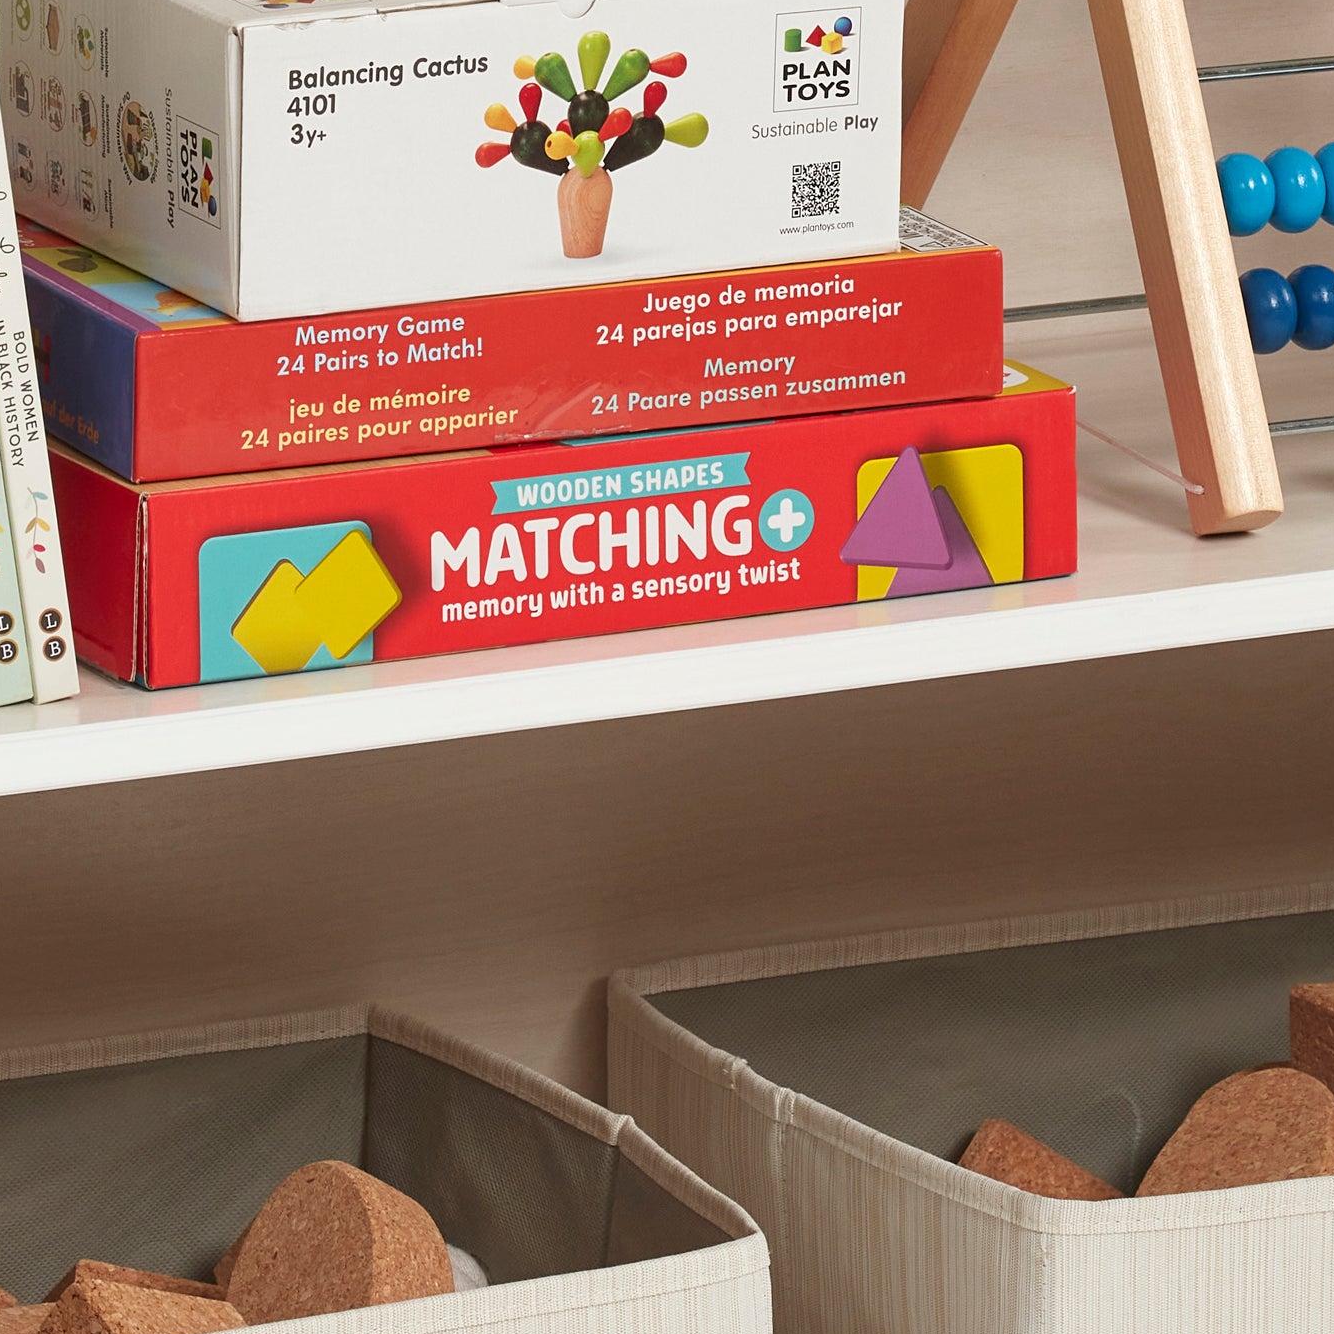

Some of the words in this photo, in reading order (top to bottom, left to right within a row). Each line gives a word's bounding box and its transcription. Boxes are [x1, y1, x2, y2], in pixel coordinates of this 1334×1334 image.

[289, 62, 403, 89] Balancing
[413, 55, 488, 78] Cactus
[783, 59, 851, 81] PLAN
[287, 93, 336, 117] 4101
[783, 80, 851, 102] TOYS
[752, 117, 838, 139] Sustainable
[845, 114, 879, 132] Play
[180, 130, 190, 203] TOYS
[189, 131, 199, 208] PLAN
[780, 220, 854, 235] www.plantoys.com
[643, 293, 711, 314] Juego
[719, 284, 746, 305] de
[754, 274, 855, 302] memoria
[295, 323, 389, 346] Memory
[397, 316, 465, 337] Game
[596, 324, 624, 345] 24
[632, 317, 717, 347] parejas
[725, 312, 777, 338] para
[785, 298, 903, 328] emparejar
[13, 331, 28, 374] BOLD
[277, 355, 305, 376] 24
[314, 350, 369, 372] Pairs
[377, 349, 399, 367] to
[407, 337, 483, 364] Match!
[704, 355, 796, 378] Memory
[20, 379, 39, 442] WOMEN
[289, 398, 324, 423] jeu
[332, 394, 361, 415] de
[370, 384, 471, 411] mémoire
[591, 394, 619, 415] 24
[628, 389, 691, 412] Paare
[700, 385, 778, 409] passen
[786, 370, 906, 396] zusammen
[3, 397, 24, 467] HISTORY
[240, 429, 269, 450] 24
[278, 423, 349, 451] paires
[357, 418, 412, 443] pour
[419, 405, 518, 436] apparier
[517, 473, 621, 507] WOODEN
[630, 462, 724, 494] SHAPES
[442, 590, 544, 623] memory
[550, 582, 604, 609] with
[611, 581, 625, 602] a
[632, 569, 730, 599] sensory
[737, 557, 801, 586] twist
